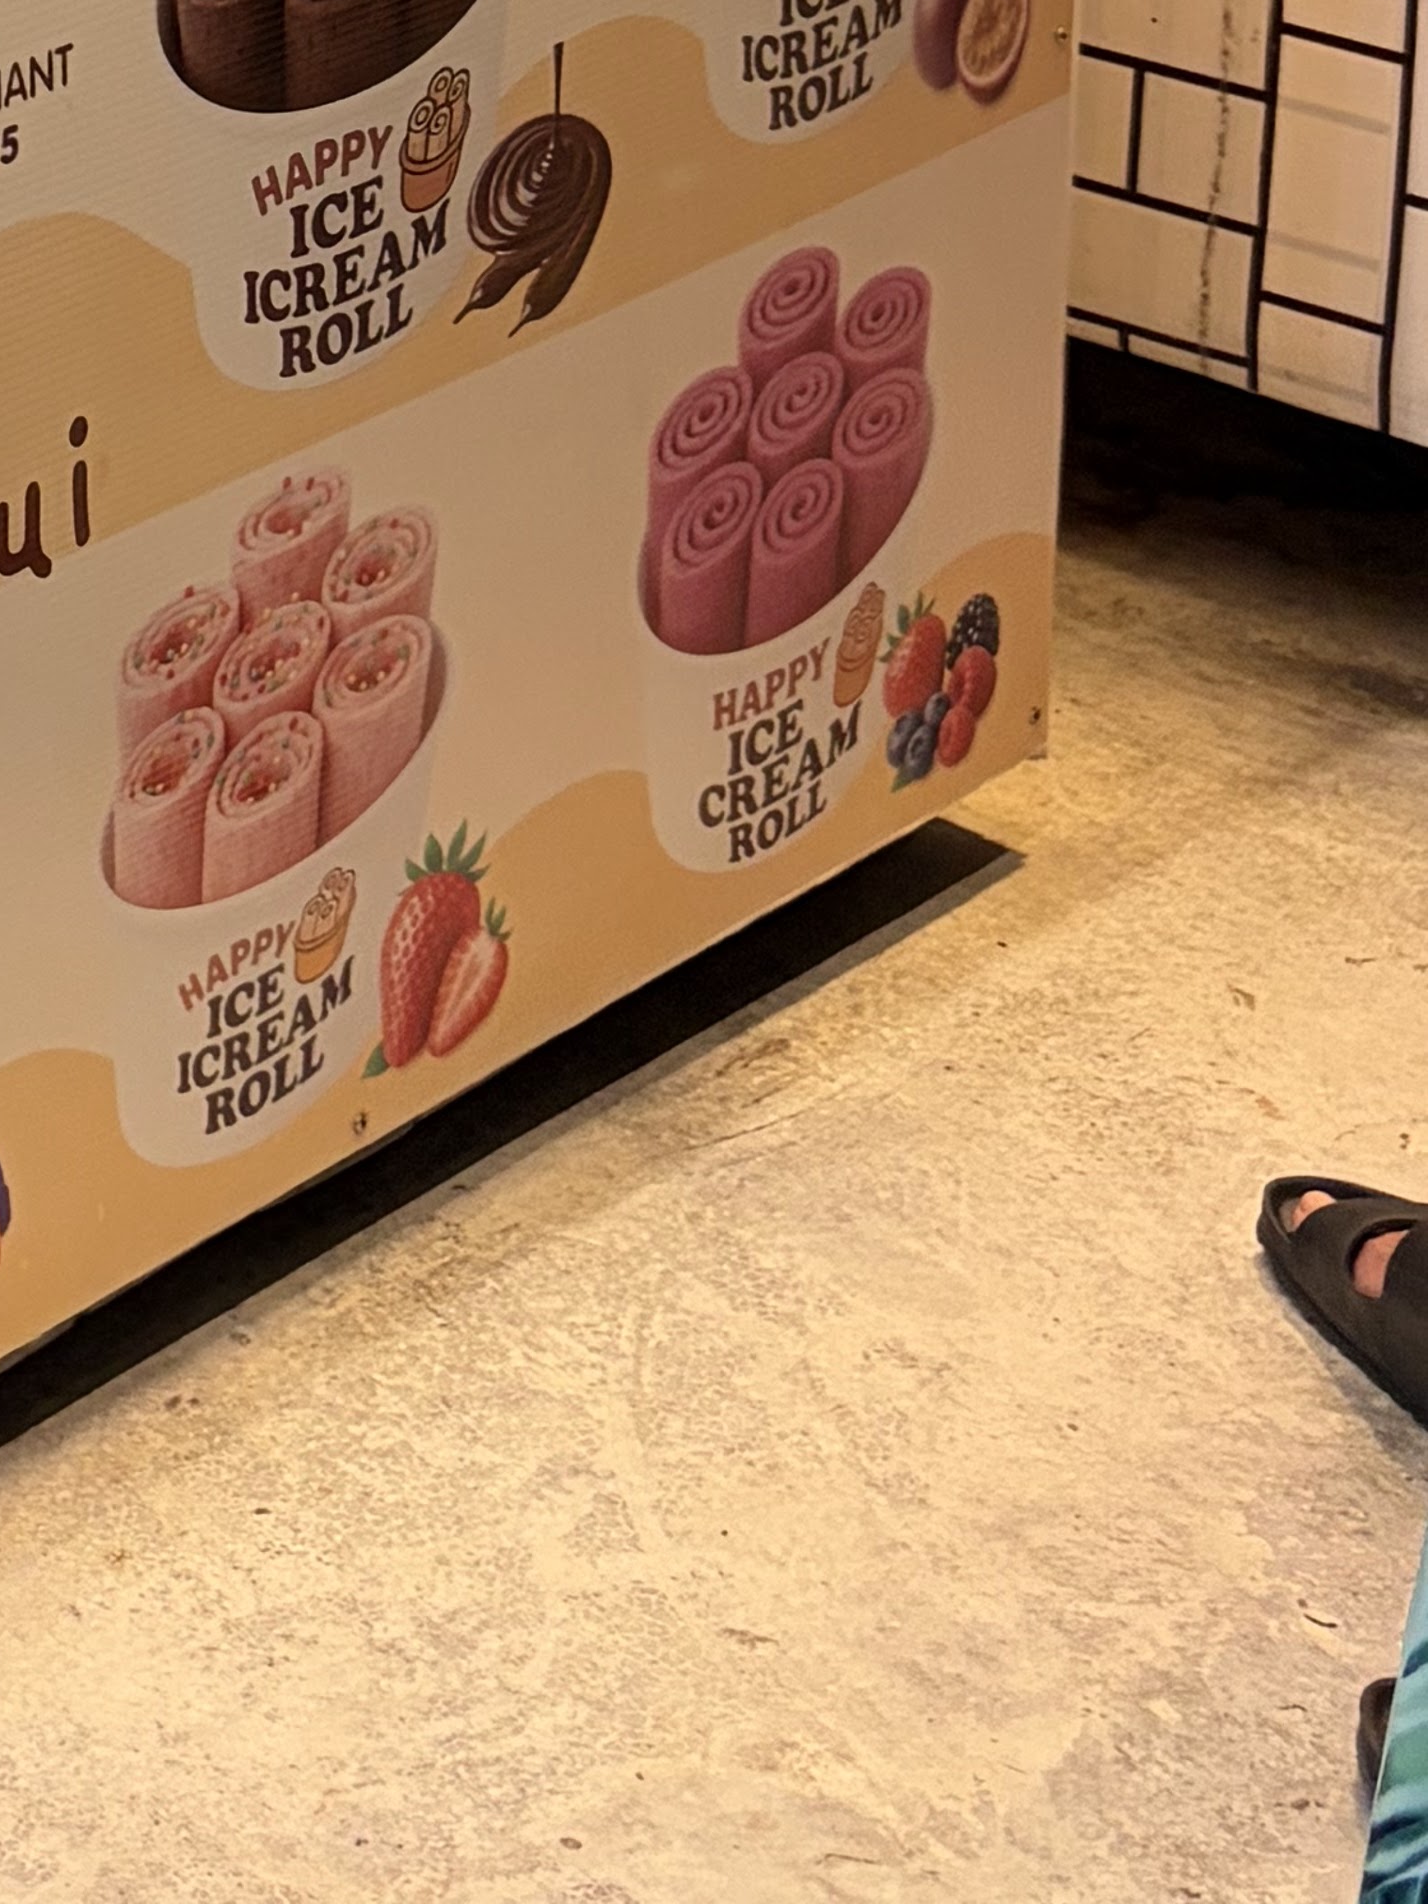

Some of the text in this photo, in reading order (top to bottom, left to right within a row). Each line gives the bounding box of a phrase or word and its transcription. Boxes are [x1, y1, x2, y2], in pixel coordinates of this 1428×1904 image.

[768, 51, 874, 131] ROLL
[251, 124, 393, 216] HAPPY
[290, 174, 384, 258] ICE
[244, 198, 450, 324] ICREAM
[279, 283, 413, 378] ROLL
[712, 637, 831, 731] HAPPY
[698, 699, 862, 828] CREAM
[727, 698, 804, 776] ICE
[728, 780, 827, 863] ROLL
[178, 920, 296, 1012] HAPPY
[206, 962, 286, 1039] ICE
[177, 954, 355, 1093] ICREAM
[204, 1034, 324, 1135] ROLL
